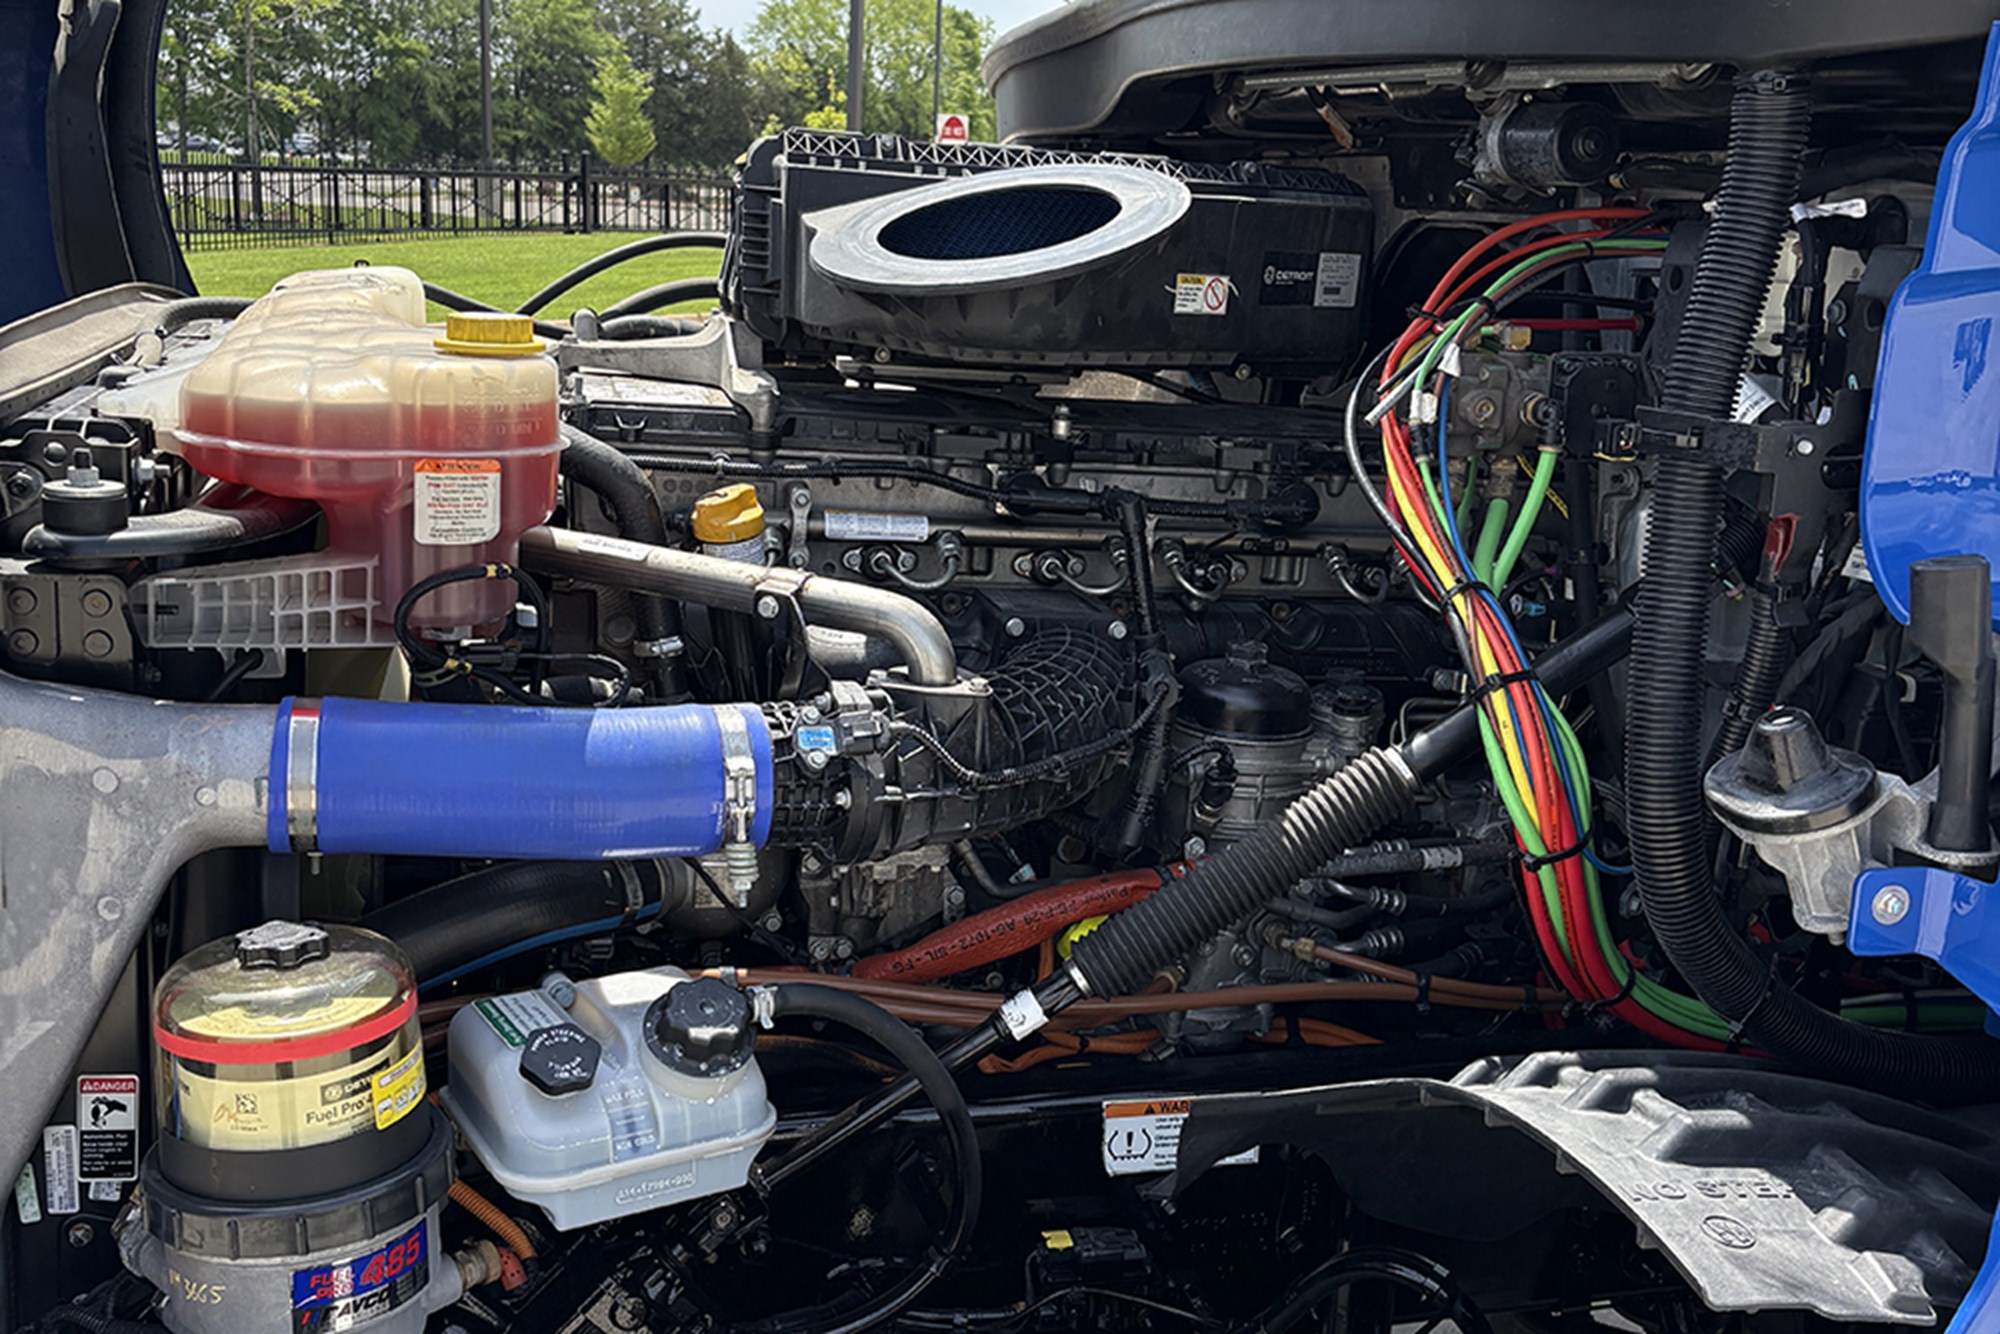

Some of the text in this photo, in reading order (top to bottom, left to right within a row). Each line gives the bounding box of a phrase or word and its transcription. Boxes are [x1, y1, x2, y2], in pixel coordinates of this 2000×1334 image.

[1275, 269, 1314, 281] DETROIT
[93, 1081, 135, 1091] DANGER
[305, 1106, 338, 1125] Fuel
[1159, 1100, 1189, 1113] WAR
[1618, 1179, 1687, 1202] NO
[360, 1232, 420, 1284] 485
[309, 1266, 355, 1288] FUEL
[315, 1281, 353, 1299] PRO
